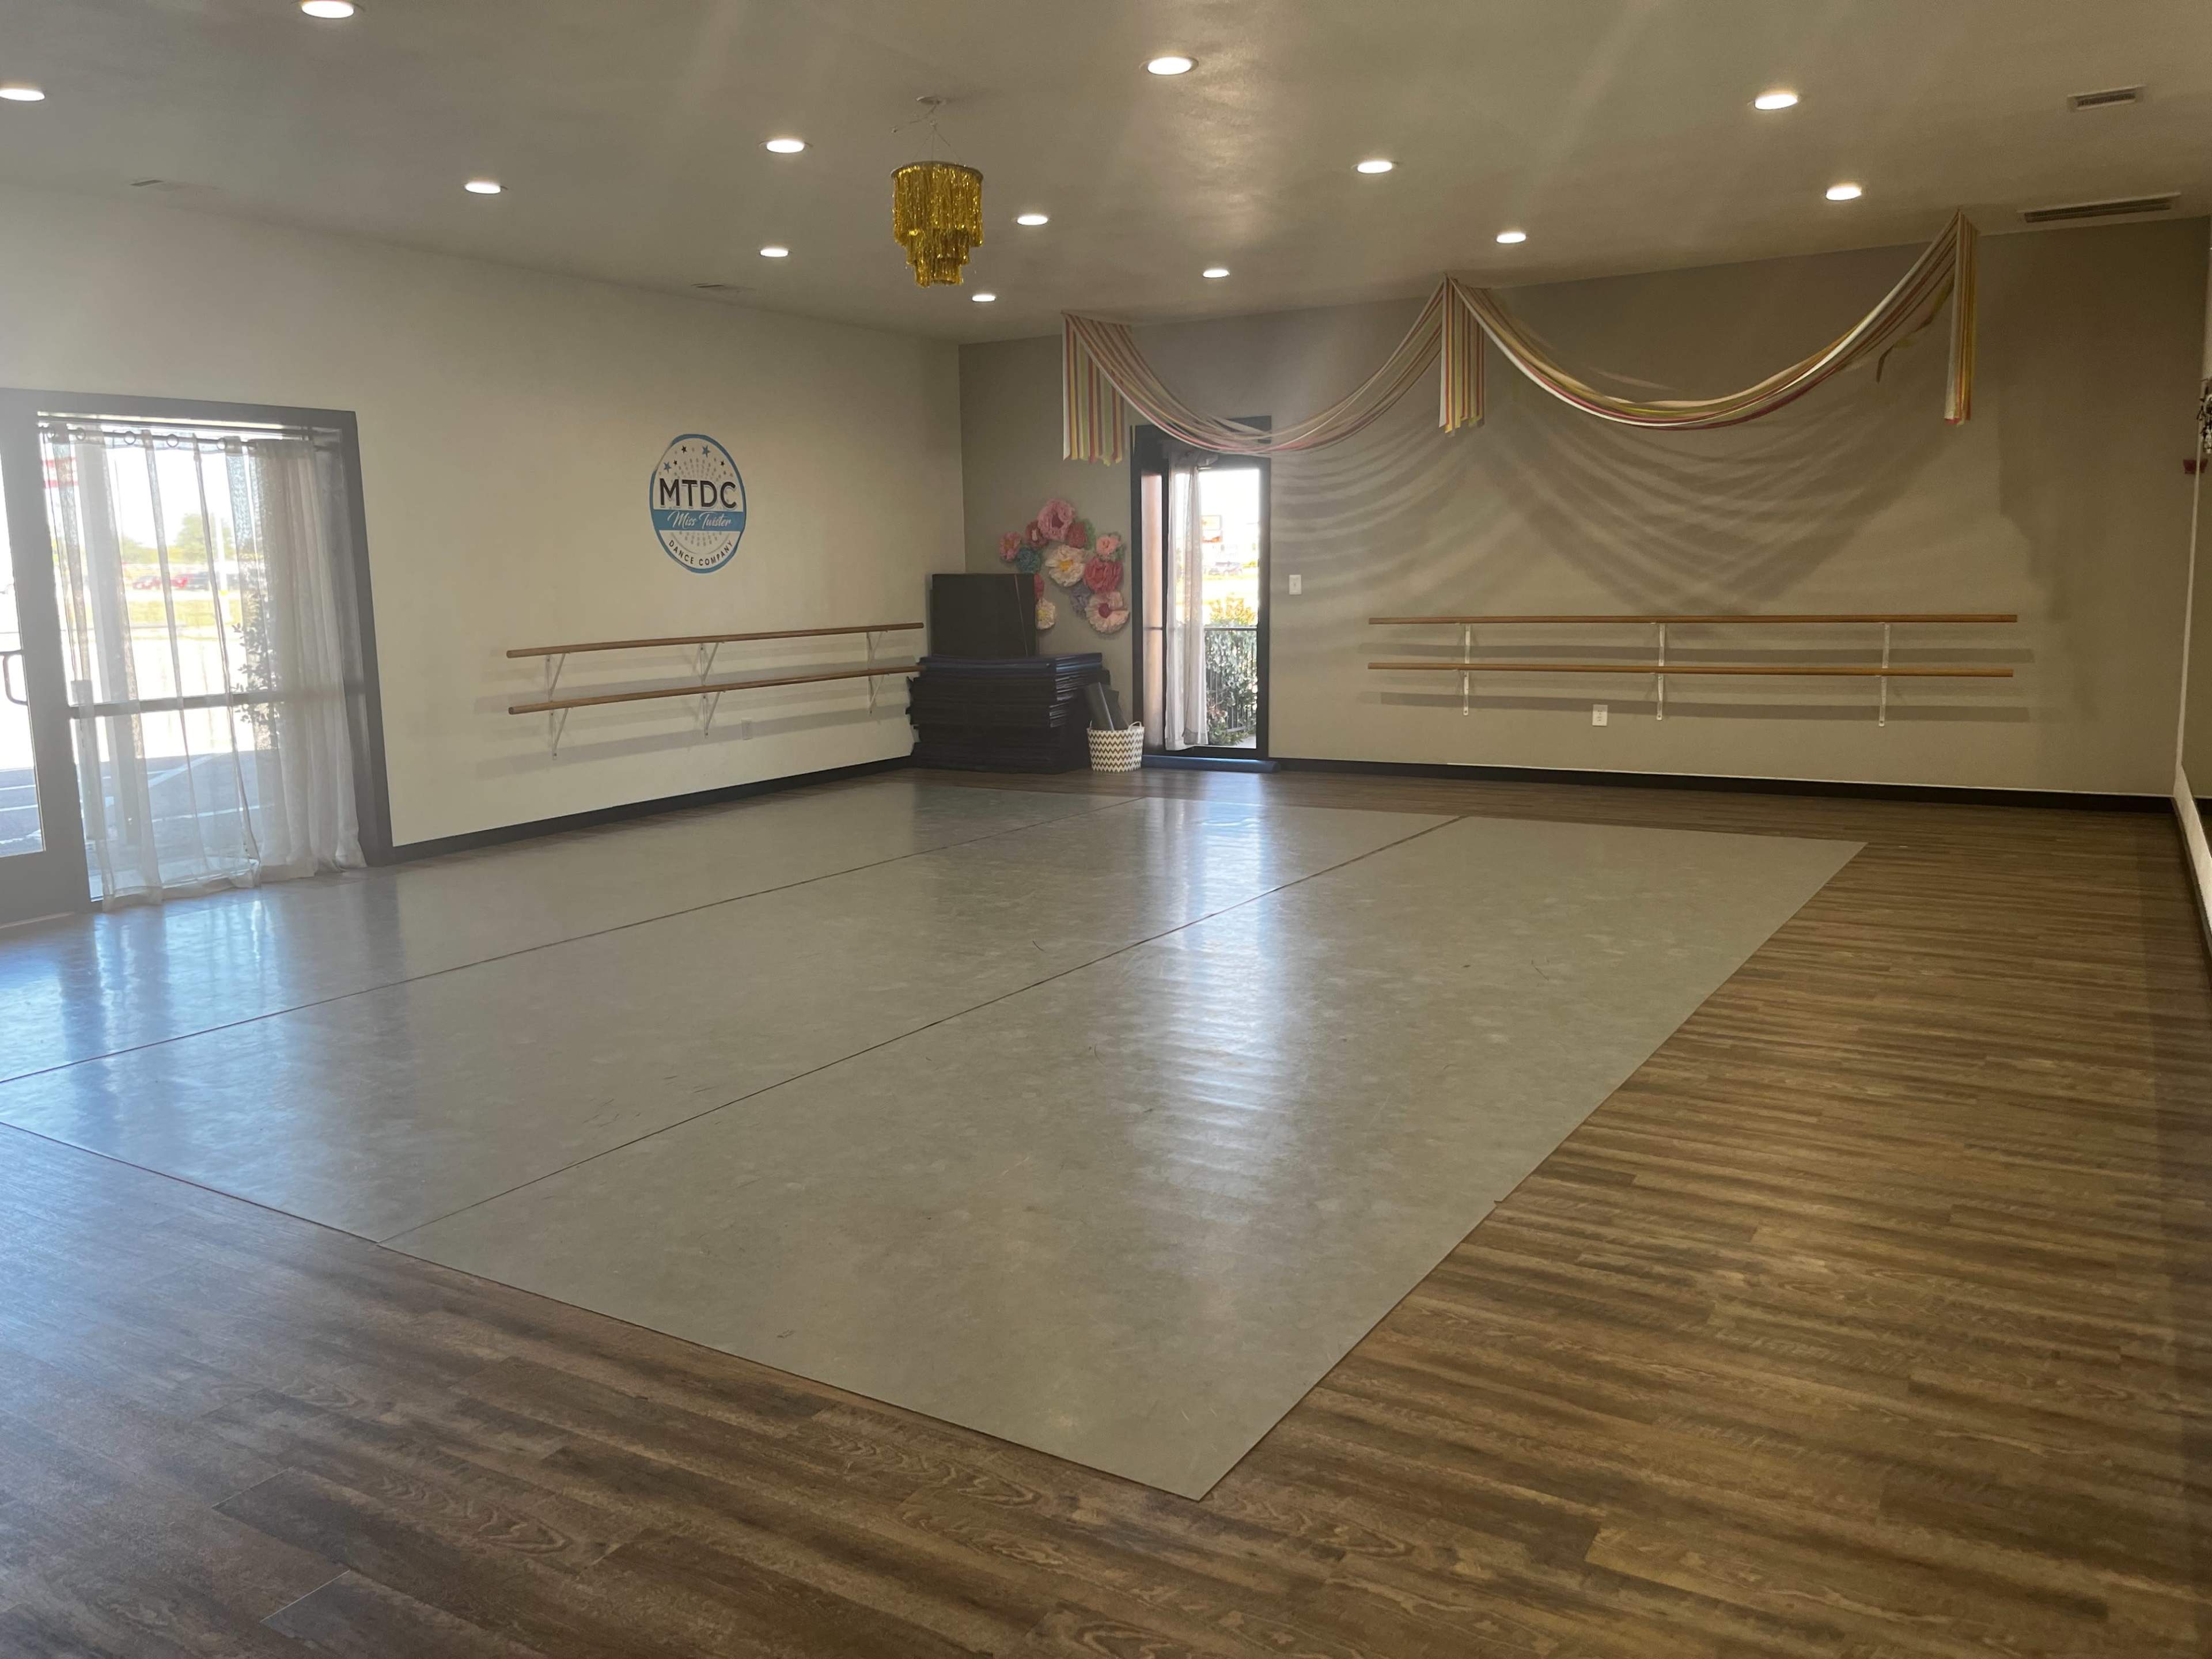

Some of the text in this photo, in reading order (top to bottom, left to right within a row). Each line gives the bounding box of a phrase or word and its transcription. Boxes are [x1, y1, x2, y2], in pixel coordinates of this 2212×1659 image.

[660, 478, 737, 509] MTDC
[667, 511, 732, 529] Miss Twister
[669, 540, 733, 566] DANCE COMPANY
